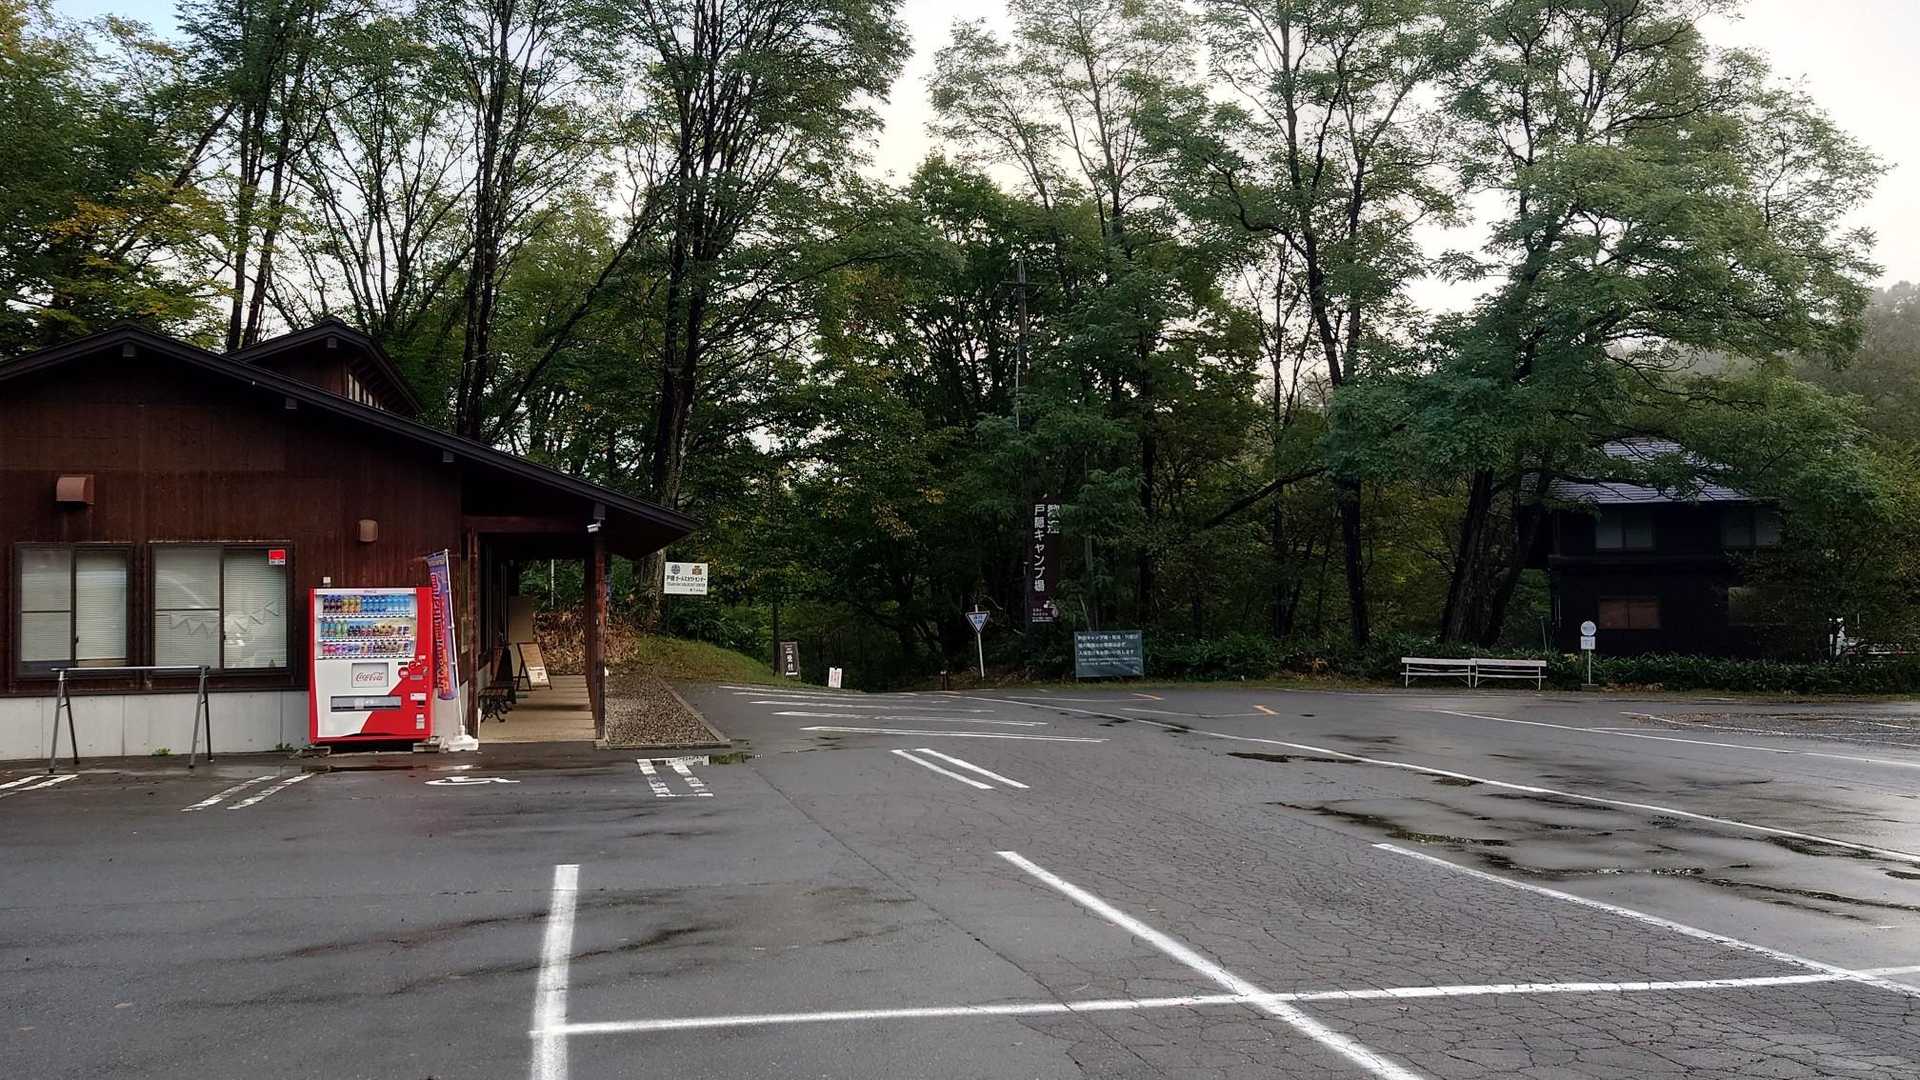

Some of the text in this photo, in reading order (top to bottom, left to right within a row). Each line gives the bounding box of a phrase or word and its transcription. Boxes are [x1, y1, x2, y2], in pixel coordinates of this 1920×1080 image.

[1034, 504, 1046, 592] 戸隠キャンプ場
